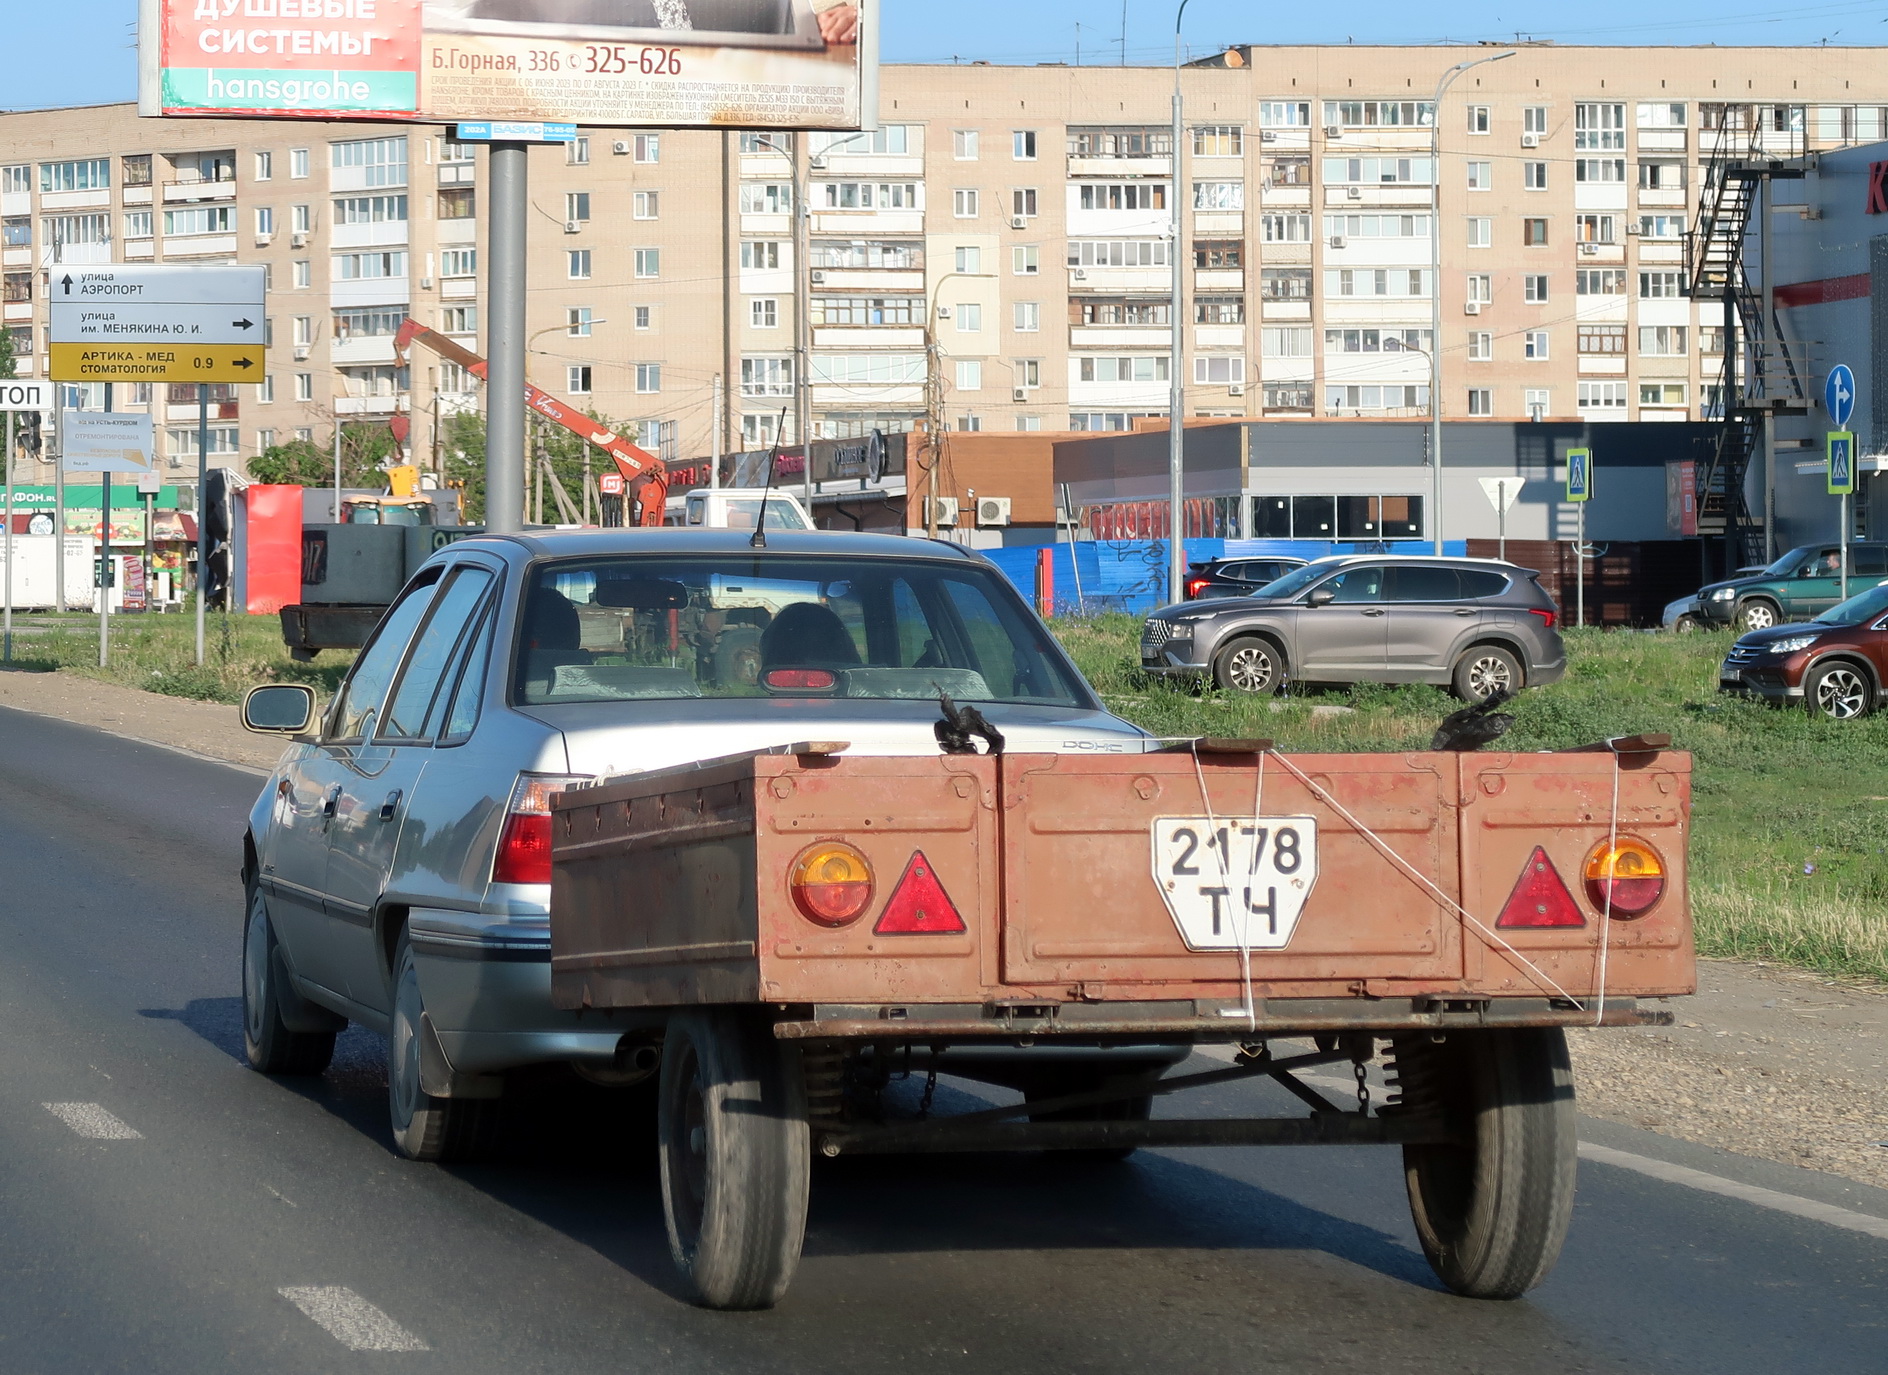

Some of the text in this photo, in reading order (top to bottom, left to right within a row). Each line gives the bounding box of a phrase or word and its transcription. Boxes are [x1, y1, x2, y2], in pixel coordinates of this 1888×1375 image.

[194, 0, 376, 20] ДУШЕВЫЕ
[199, 28, 372, 55] СИСТЕМЫ
[432, 45, 681, 75] Б.Горная, 336 325-626
[207, 68, 370, 105] hansgrohe
[81, 273, 114, 283] улица
[81, 285, 144, 295] АЭРОПОРТ
[81, 312, 115, 322] улица
[103, 324, 169, 334] МЕНЯКИНА
[173, 325, 188, 334] Ю.
[191, 325, 202, 334] И.
[81, 352, 133, 361] АРТИКА
[146, 353, 175, 363] МЕД
[81, 364, 166, 374] стоматология
[193, 358, 213, 369] 0.9
[74, 433, 140, 441] ОТРЕМОНТИРОВАНА
[1062, 741, 1123, 752] DOHC
[1172, 826, 1302, 876] 2178
[1199, 886, 1277, 936] ТЧ
